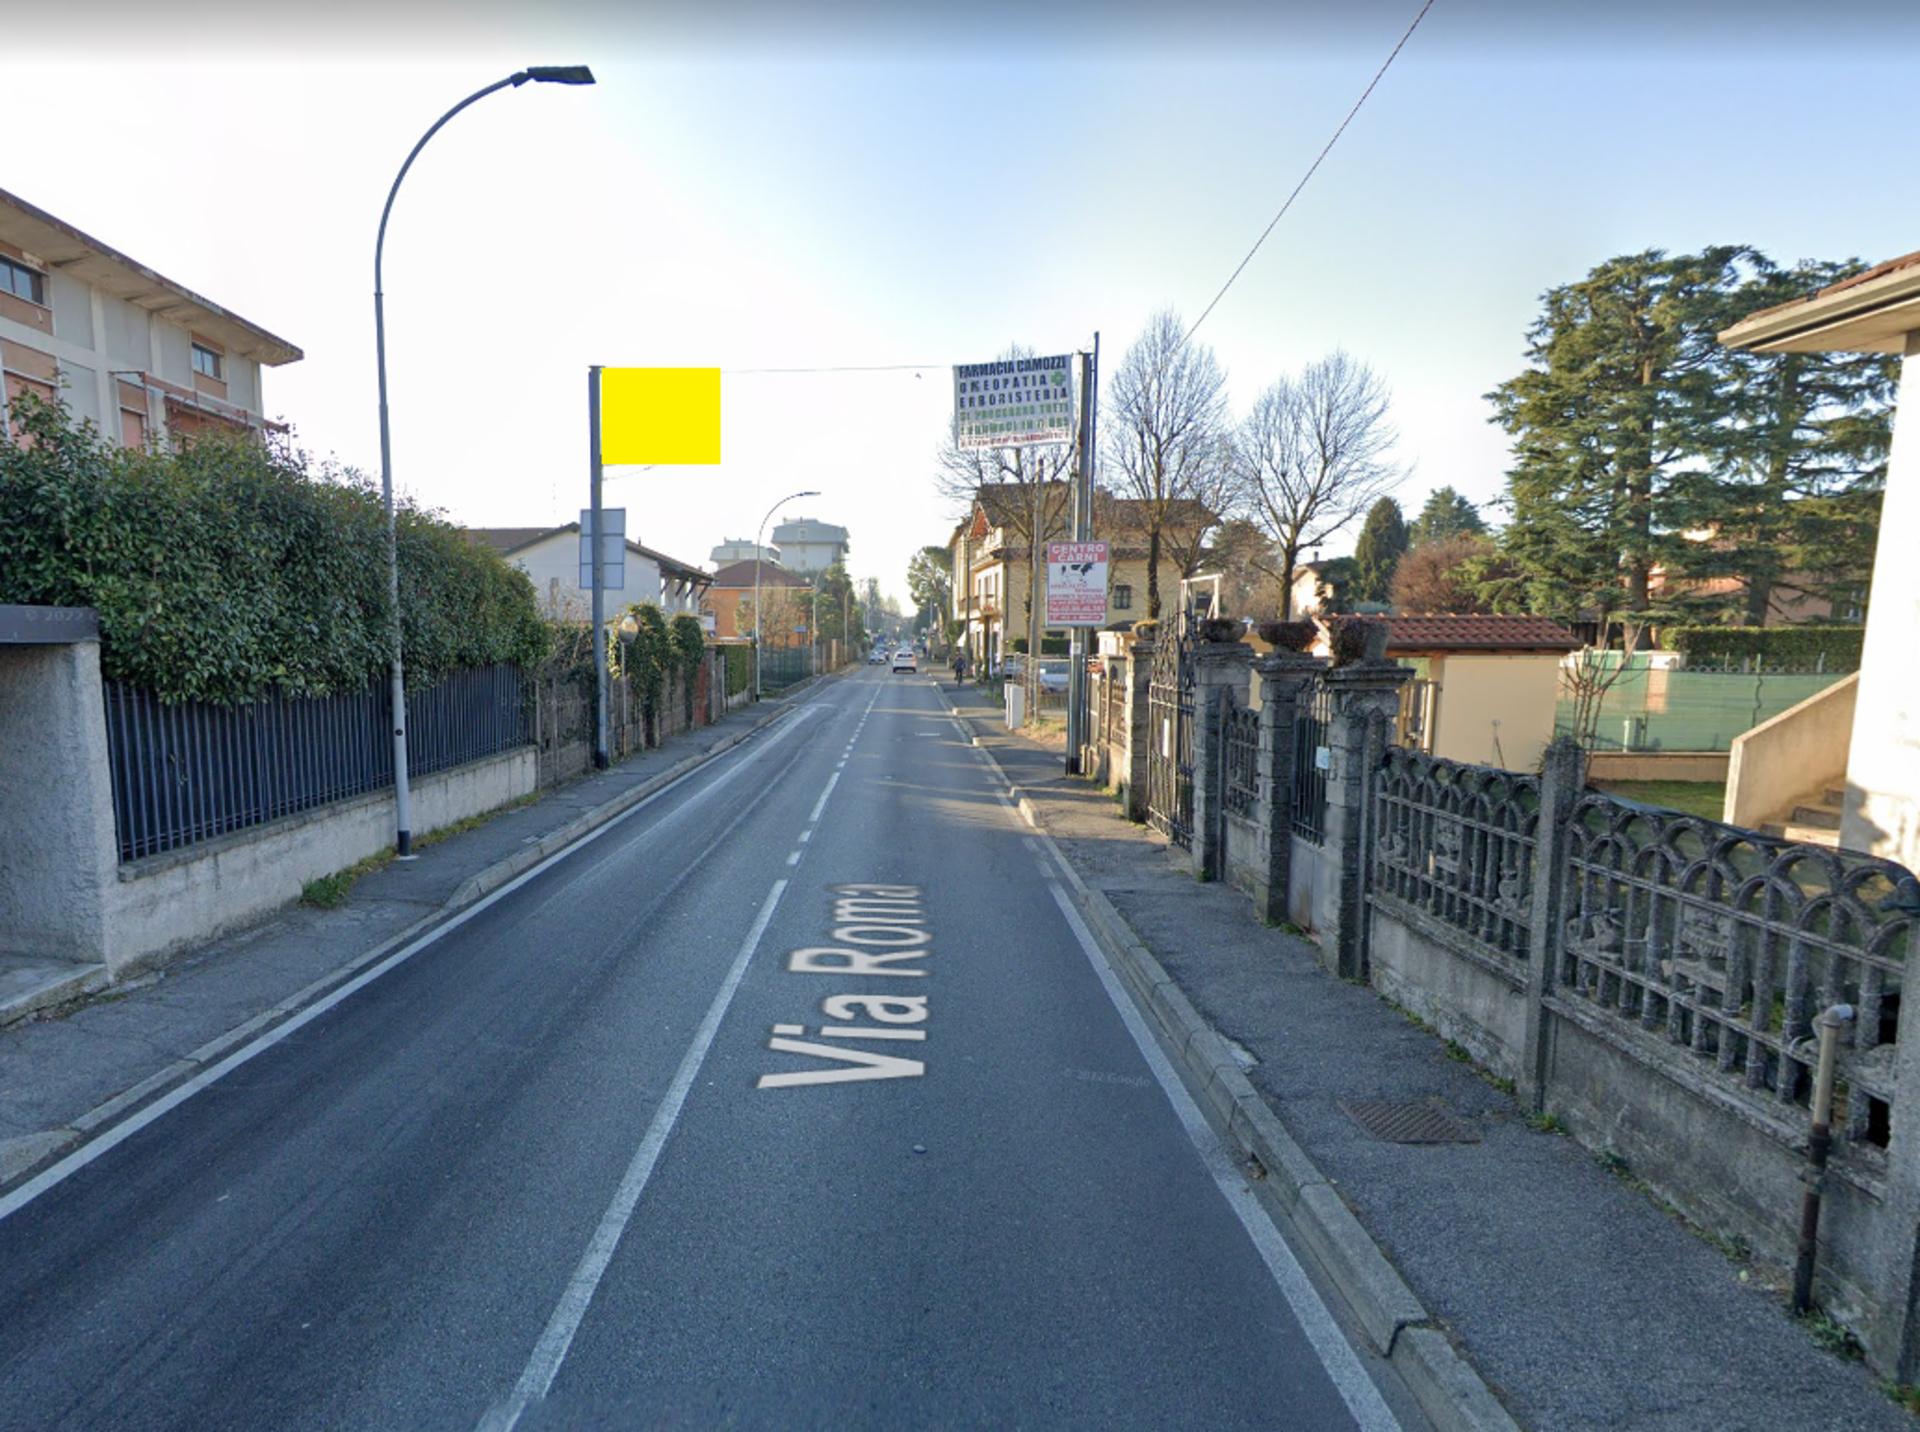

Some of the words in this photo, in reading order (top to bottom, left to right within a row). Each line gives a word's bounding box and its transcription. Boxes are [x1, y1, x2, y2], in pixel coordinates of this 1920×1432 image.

[959, 361, 1014, 378] FARMACIA
[1017, 356, 1066, 372] CAMOZZI
[959, 374, 1047, 394] OMEOPATIA
[960, 388, 1068, 408] ERBORISTERIA
[1052, 544, 1104, 555] CENTRO
[1058, 553, 1098, 562] CARNI
